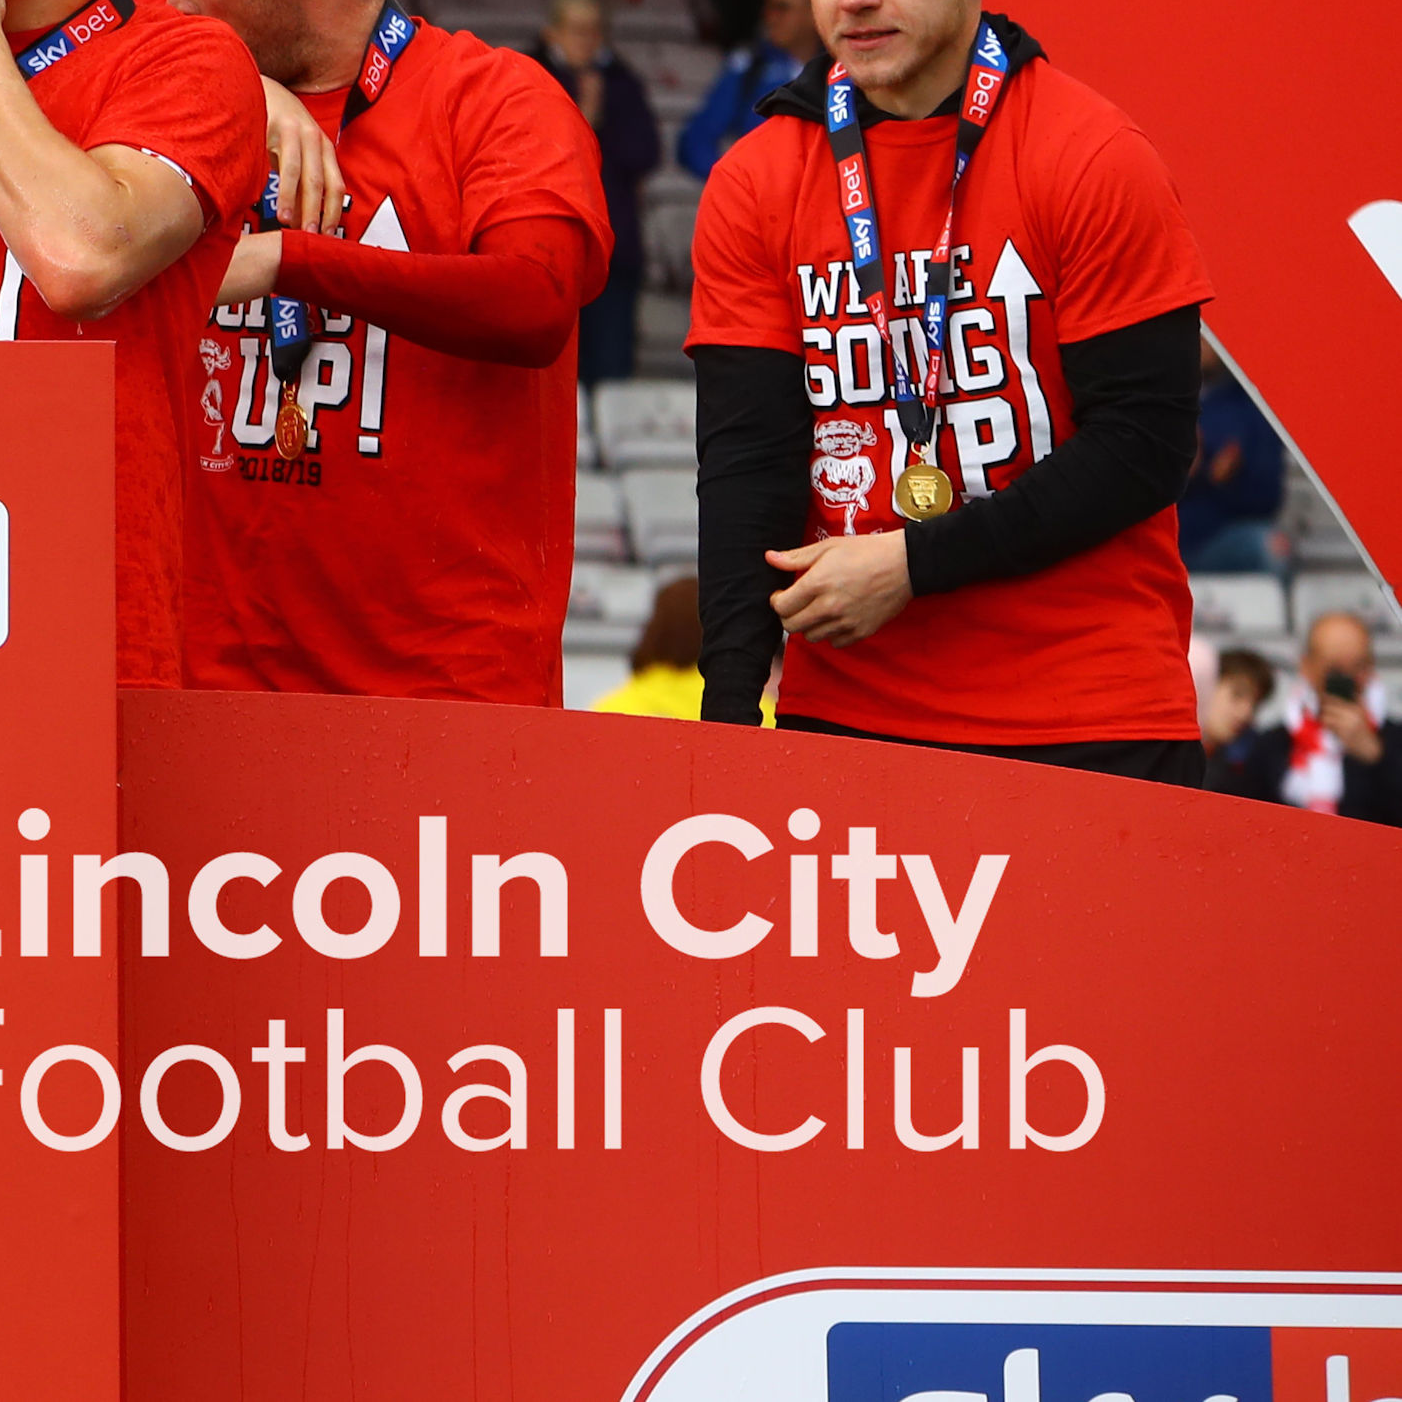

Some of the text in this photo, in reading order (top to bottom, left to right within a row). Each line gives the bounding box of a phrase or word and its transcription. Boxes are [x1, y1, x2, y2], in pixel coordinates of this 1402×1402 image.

[28, 5, 115, 72] sky bet
[365, 15, 407, 93] sky bet
[829, 85, 851, 123] sky
[969, 72, 1001, 119] bet
[843, 161, 872, 260] sky bet
[276, 299, 300, 339] sky
